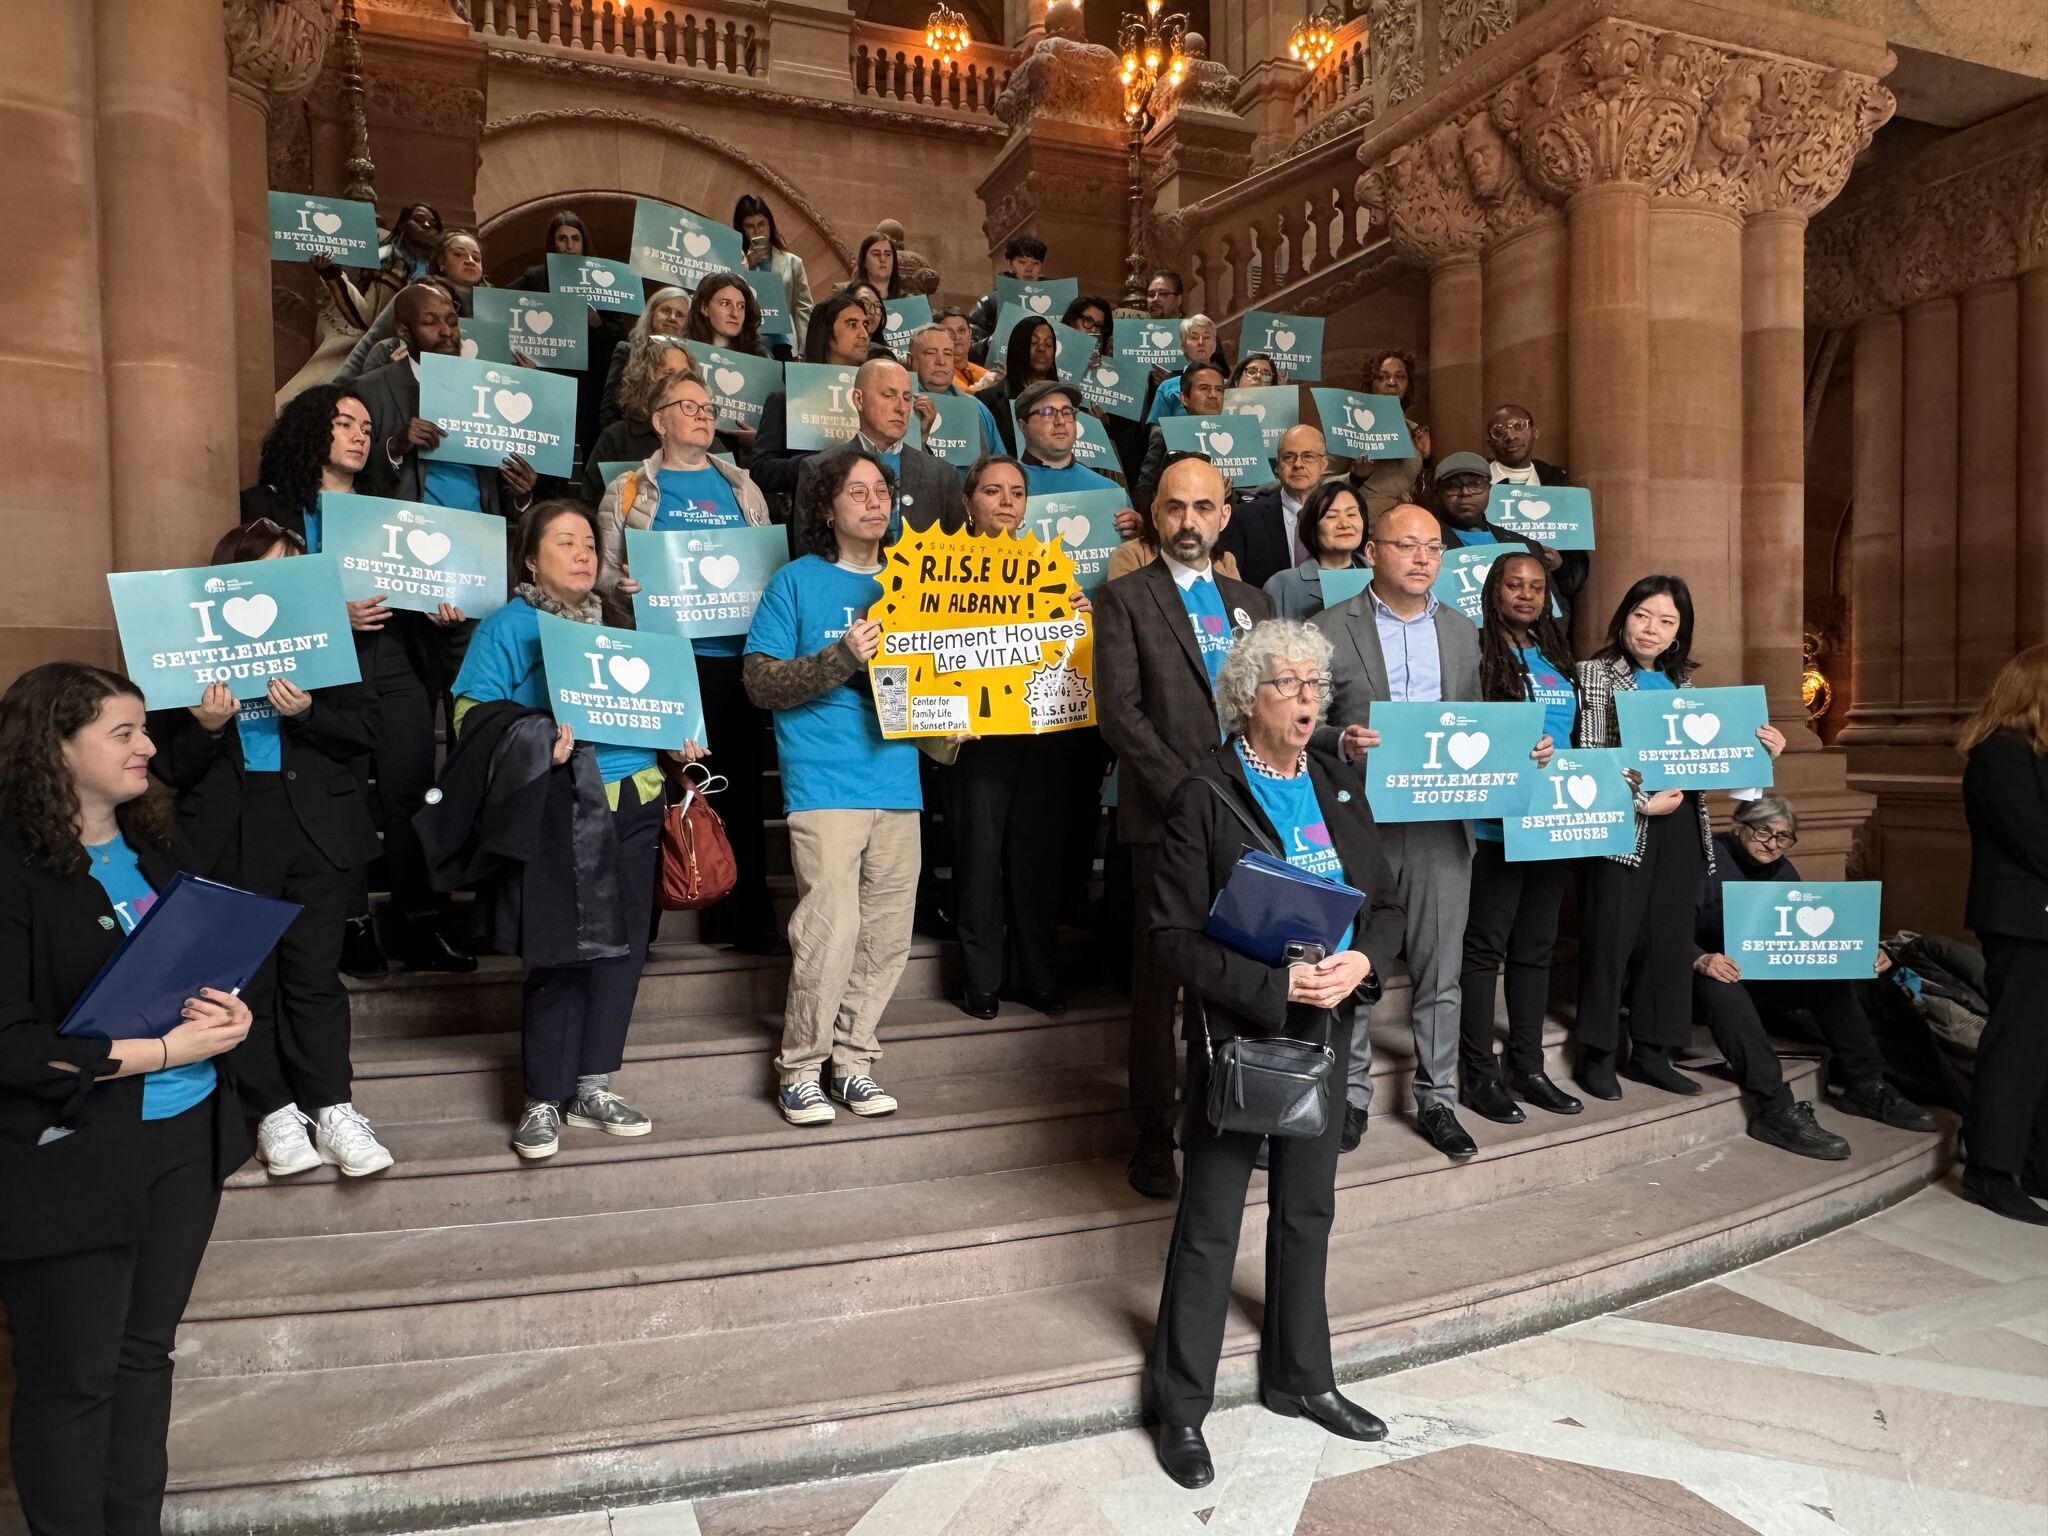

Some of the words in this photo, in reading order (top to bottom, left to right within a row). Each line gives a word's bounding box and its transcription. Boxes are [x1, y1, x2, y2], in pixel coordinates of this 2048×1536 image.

[296, 209, 312, 232] I
[274, 231, 367, 249] SETTLEMENT
[295, 241, 348, 257] HOUSES
[667, 226, 682, 252] I
[643, 246, 731, 274] SETTLEMENT
[578, 268, 591, 285] I
[560, 285, 635, 301] SETTLEMENT
[577, 294, 620, 304] OUSES
[509, 308, 523, 332] I
[1139, 331, 1150, 348] I
[1264, 330, 1275, 349] I
[1122, 349, 1184, 357] SETTLEMEN
[1137, 356, 1176, 364] HOUSES
[471, 385, 491, 419] I
[828, 385, 843, 412] I
[1343, 405, 1355, 428] I
[438, 418, 560, 446] SETTLEMENT
[1331, 426, 1399, 440] SETTLEMENT
[464, 435, 536, 456] HOUSES
[1195, 432, 1210, 455] I
[1347, 439, 1385, 450] HOUSES
[1500, 499, 1516, 520] I
[382, 523, 404, 561] I
[930, 542, 986, 554] SUNSET
[997, 548, 1034, 557] PARK
[343, 556, 487, 587] SETTLEMENT
[676, 557, 698, 590] I
[920, 555, 991, 584] R.I.S.E
[1452, 567, 1477, 592] I
[374, 576, 455, 599] HOUSES
[920, 592, 940, 613] IN
[189, 600, 222, 643] I
[675, 606, 751, 622] HOUSES
[843, 607, 854, 627] I
[1189, 613, 1204, 633] I
[886, 627, 997, 653] Settlement
[1005, 622, 1086, 643] Houses
[152, 633, 329, 669] SETTLEMENT
[938, 653, 967, 671] Are
[975, 646, 1041, 667] VITAL!
[196, 657, 297, 684] HOUSES
[584, 652, 609, 690] I
[1526, 673, 1541, 688] I
[560, 689, 684, 716] SETTLEMENT
[912, 697, 937, 706] Center
[939, 696, 950, 706] for
[587, 711, 662, 730] HOUSES
[912, 708, 936, 719] Family
[937, 708, 952, 718] Life
[1042, 717, 1067, 727] SUNSET
[1069, 714, 1088, 722] PARK
[912, 721, 919, 730] in
[920, 721, 946, 730] Sunset
[948, 720, 968, 730] Park
[1662, 714, 1682, 745] I
[1422, 731, 1445, 769] I
[1638, 746, 1754, 762] SETTLEMENT
[1664, 761, 1730, 776] HOUSES
[1386, 773, 1518, 789] SETTLEMENT
[1549, 774, 1568, 809] I
[1412, 789, 1488, 804] HOUSES
[1521, 811, 1625, 829] SETTLEMENT
[1294, 826, 1309, 852] I
[1550, 825, 1608, 842] HOUSES
[1774, 906, 1793, 938] I
[1742, 939, 1863, 952] SETTLEMENT
[1768, 952, 1838, 965] HOUSES
